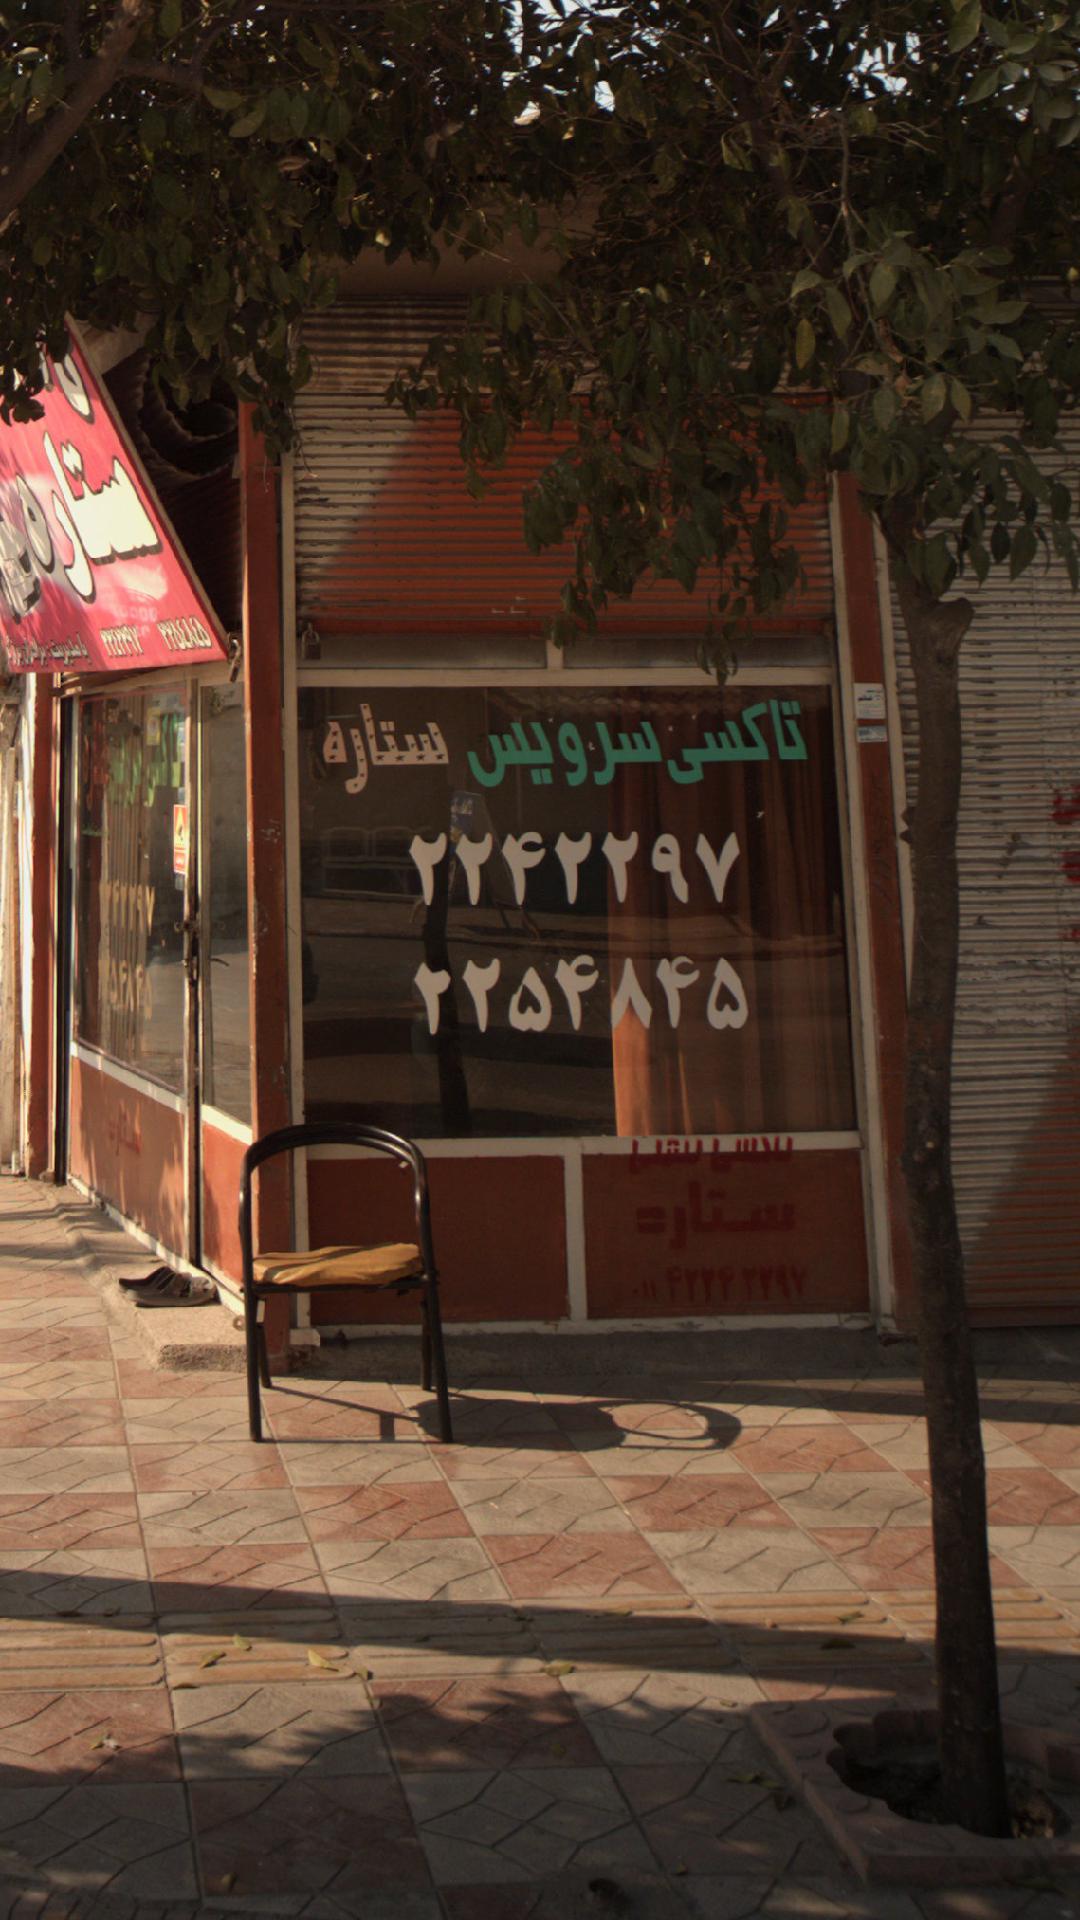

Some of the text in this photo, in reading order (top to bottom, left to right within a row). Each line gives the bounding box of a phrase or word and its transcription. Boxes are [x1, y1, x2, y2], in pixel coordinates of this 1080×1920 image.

[16, 432, 164, 604] ستاره
[323, 700, 808, 794] تاکسی سرویس ستاره
[408, 831, 740, 906] ۲۲۴۲۲۹۷
[413, 954, 749, 1035] ۲۲۵۴۸۴۵
[635, 1180, 796, 1250] ستاره
